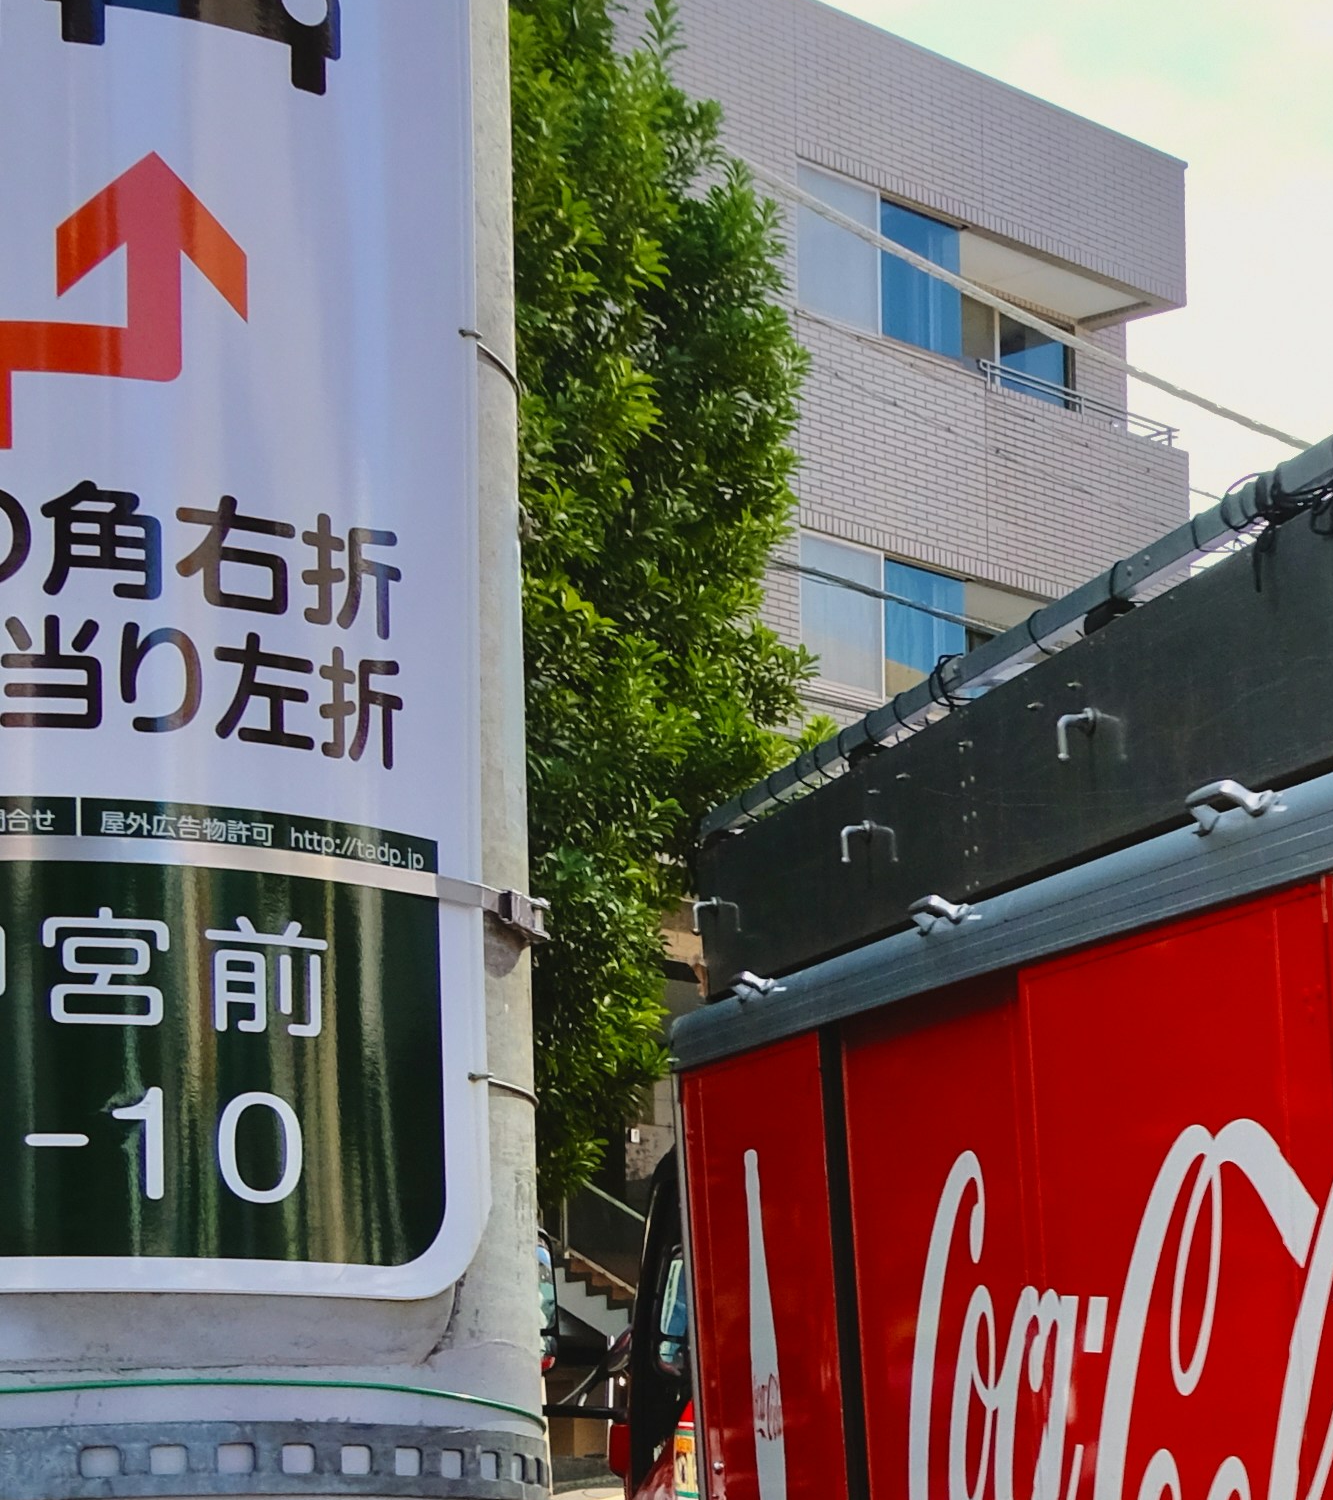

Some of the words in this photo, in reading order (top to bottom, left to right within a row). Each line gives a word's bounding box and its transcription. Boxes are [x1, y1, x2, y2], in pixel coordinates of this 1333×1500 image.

[0, 614, 403, 770] 当り左折
[0, 808, 55, 831] 合せ
[100, 810, 274, 846] 屋外広告物許可
[290, 827, 425, 870] http://tadp.jp
[0, 906, 328, 1037] 宮前
